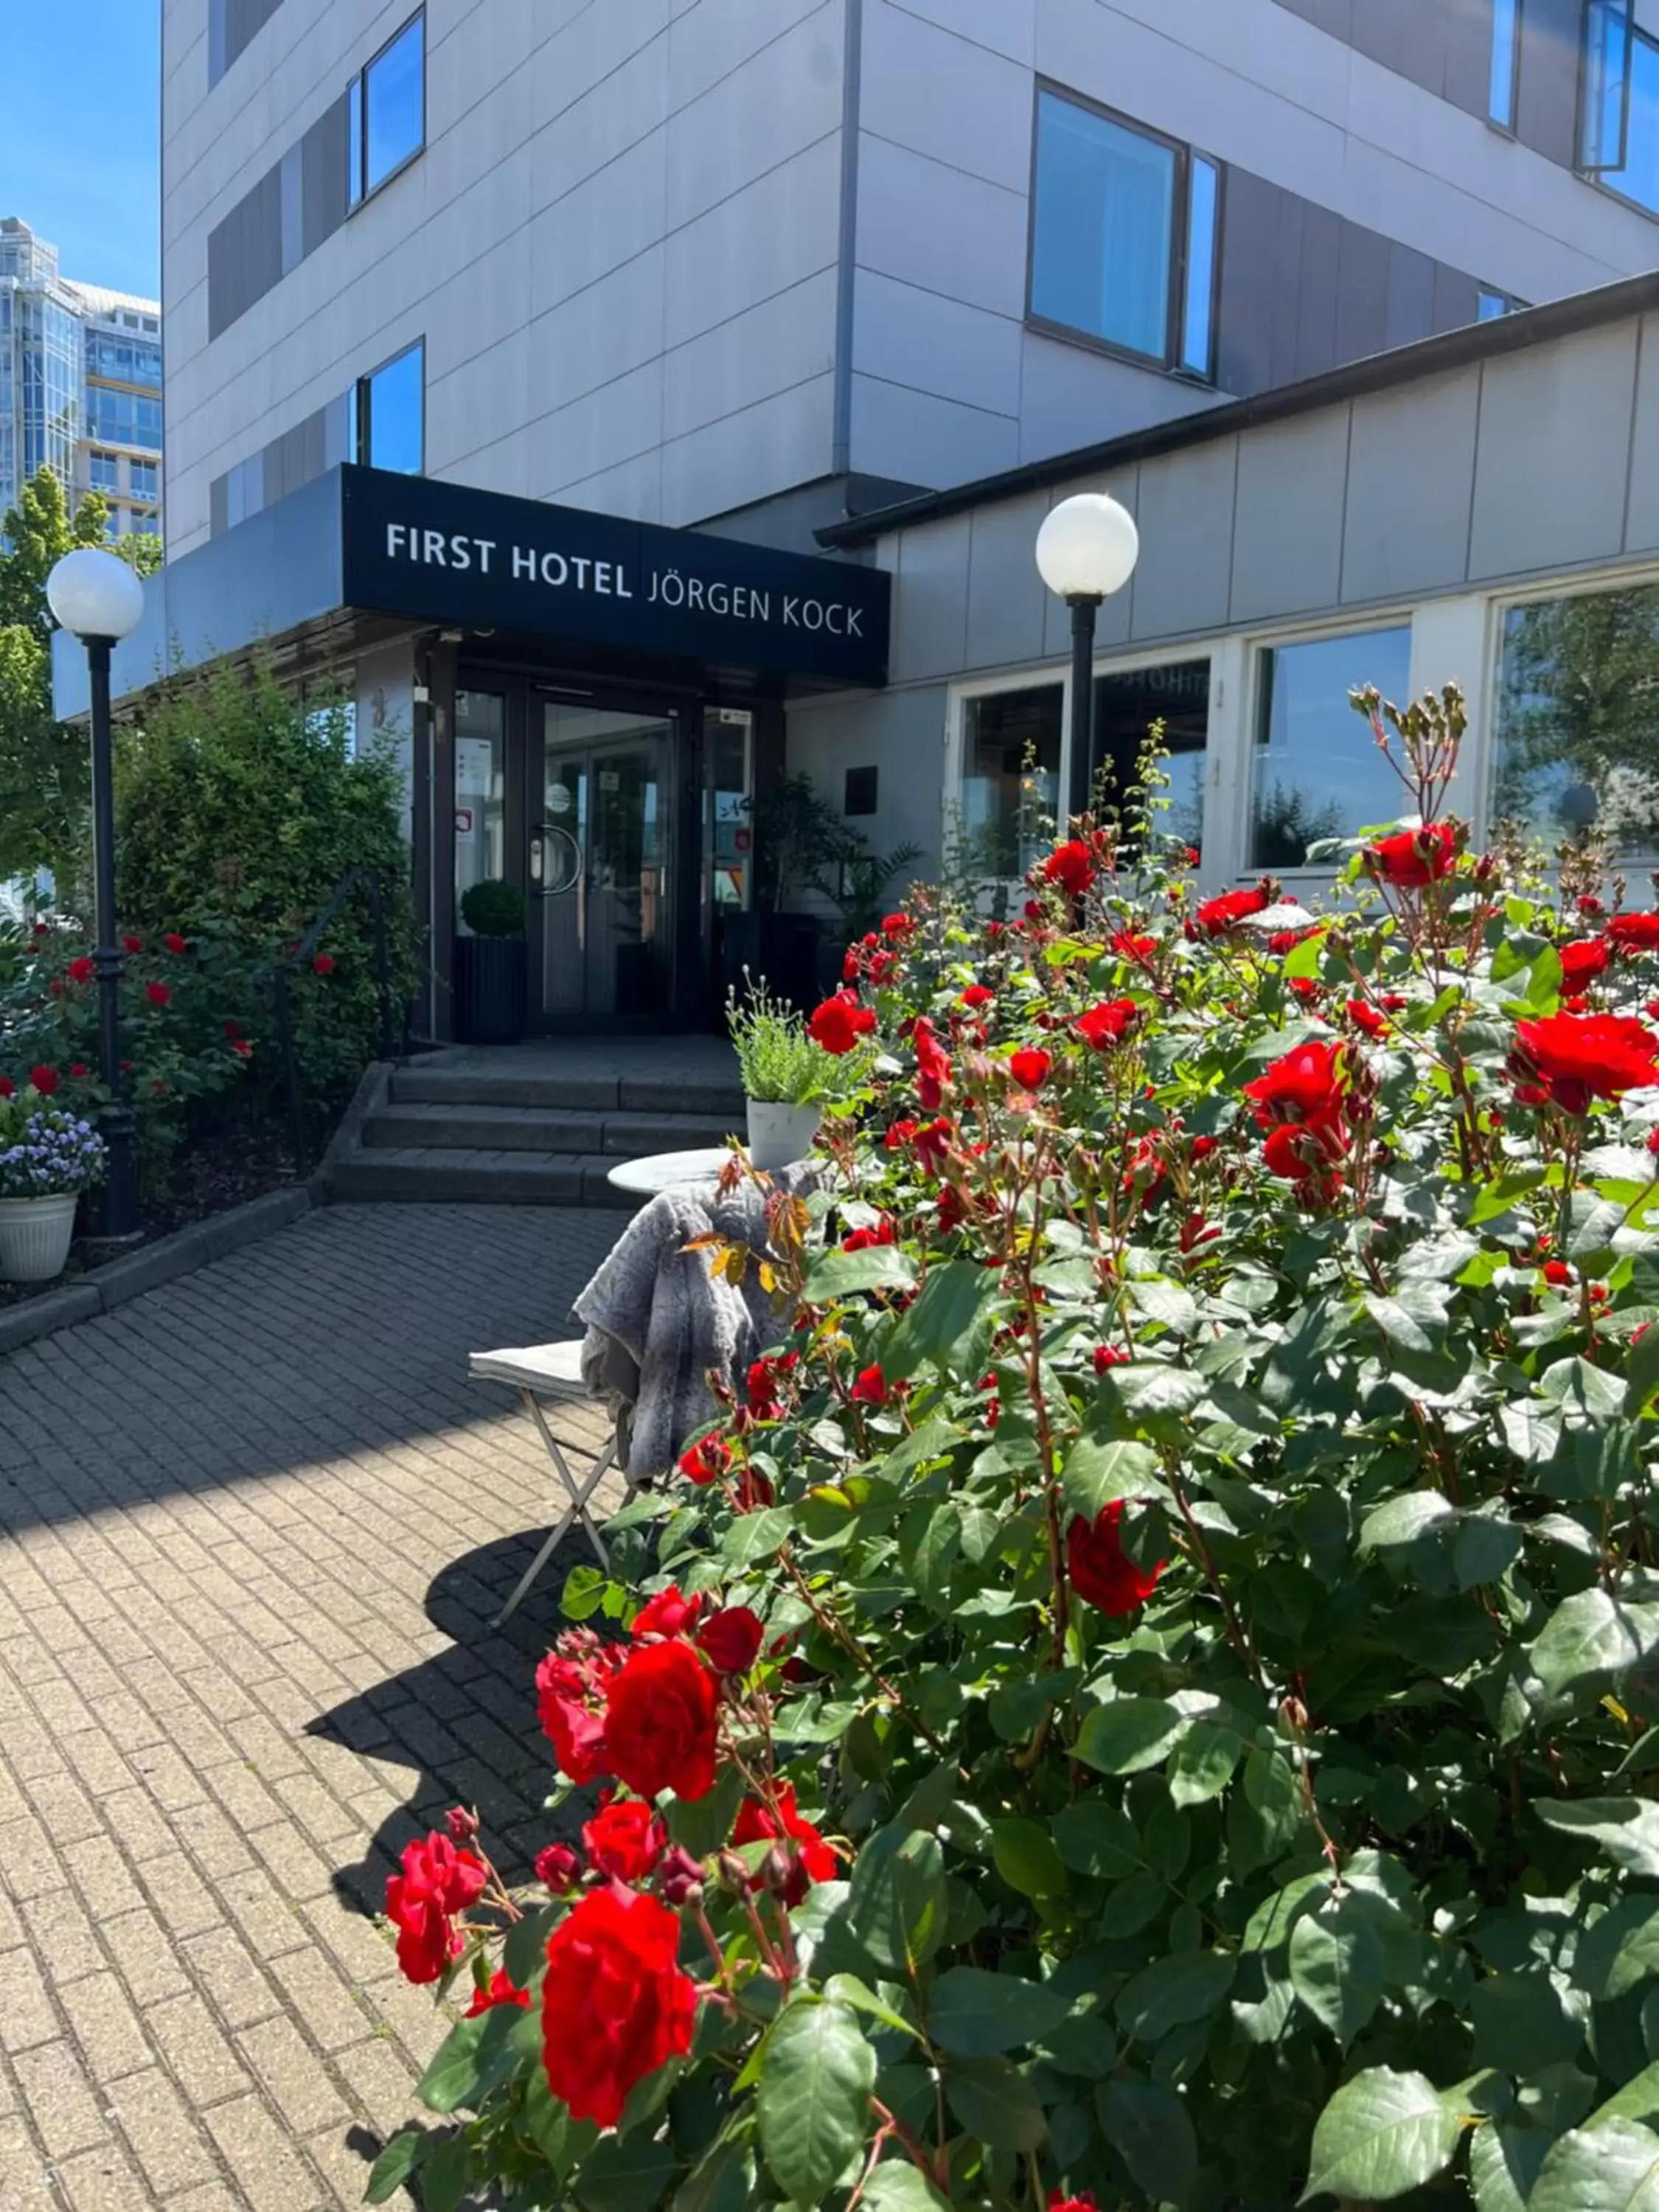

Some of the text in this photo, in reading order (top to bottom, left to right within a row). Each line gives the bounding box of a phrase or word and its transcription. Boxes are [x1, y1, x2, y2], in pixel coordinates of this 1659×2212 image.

[387, 523, 863, 637] FIRST HOTEL JÖRGEN KOCK
